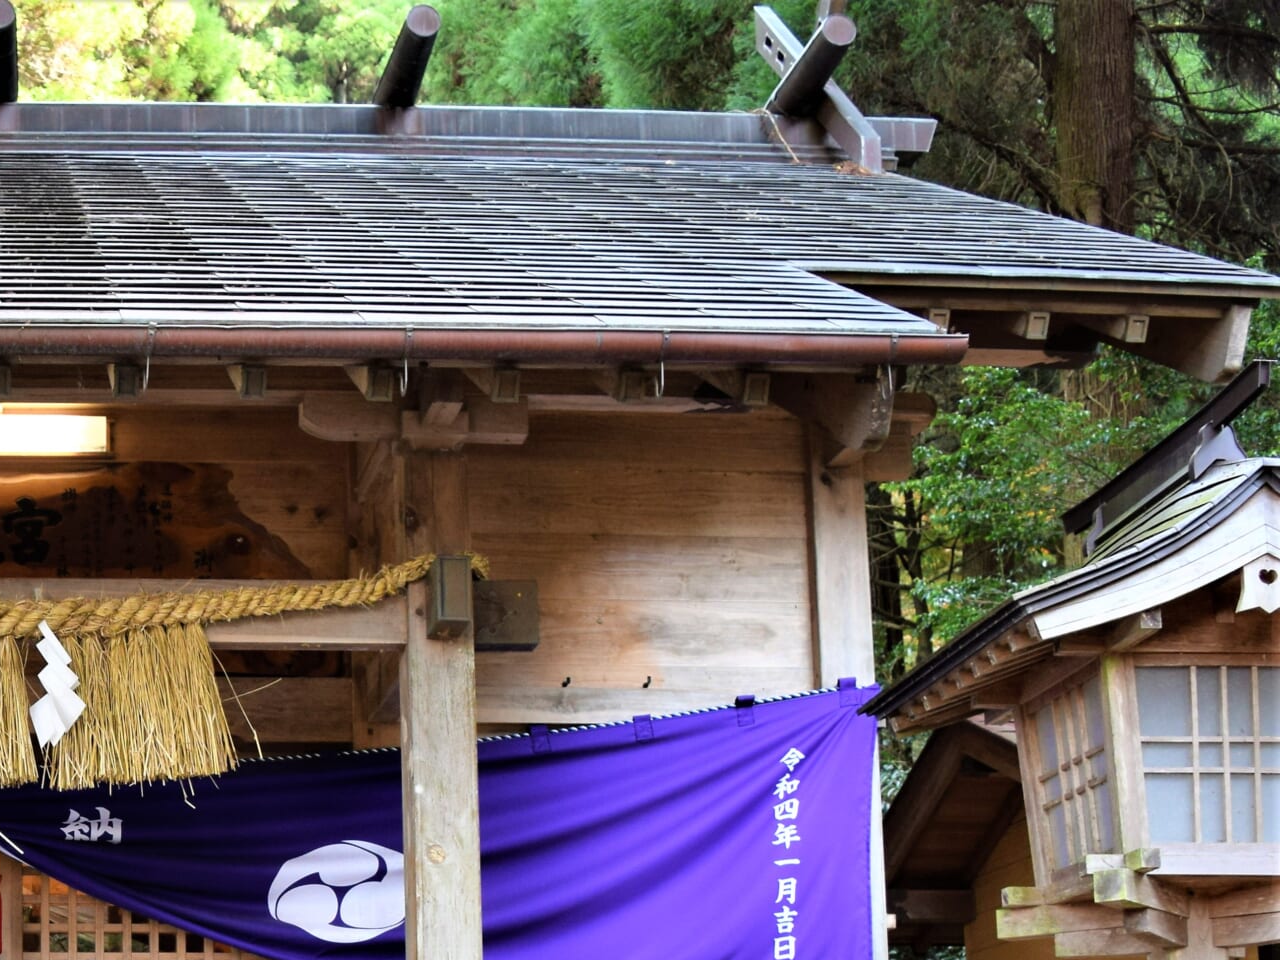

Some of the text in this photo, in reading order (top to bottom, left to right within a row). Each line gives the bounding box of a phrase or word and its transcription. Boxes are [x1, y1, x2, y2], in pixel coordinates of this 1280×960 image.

[60, 806, 123, 845] 納
[772, 747, 805, 960] 令和四年一月吉日
